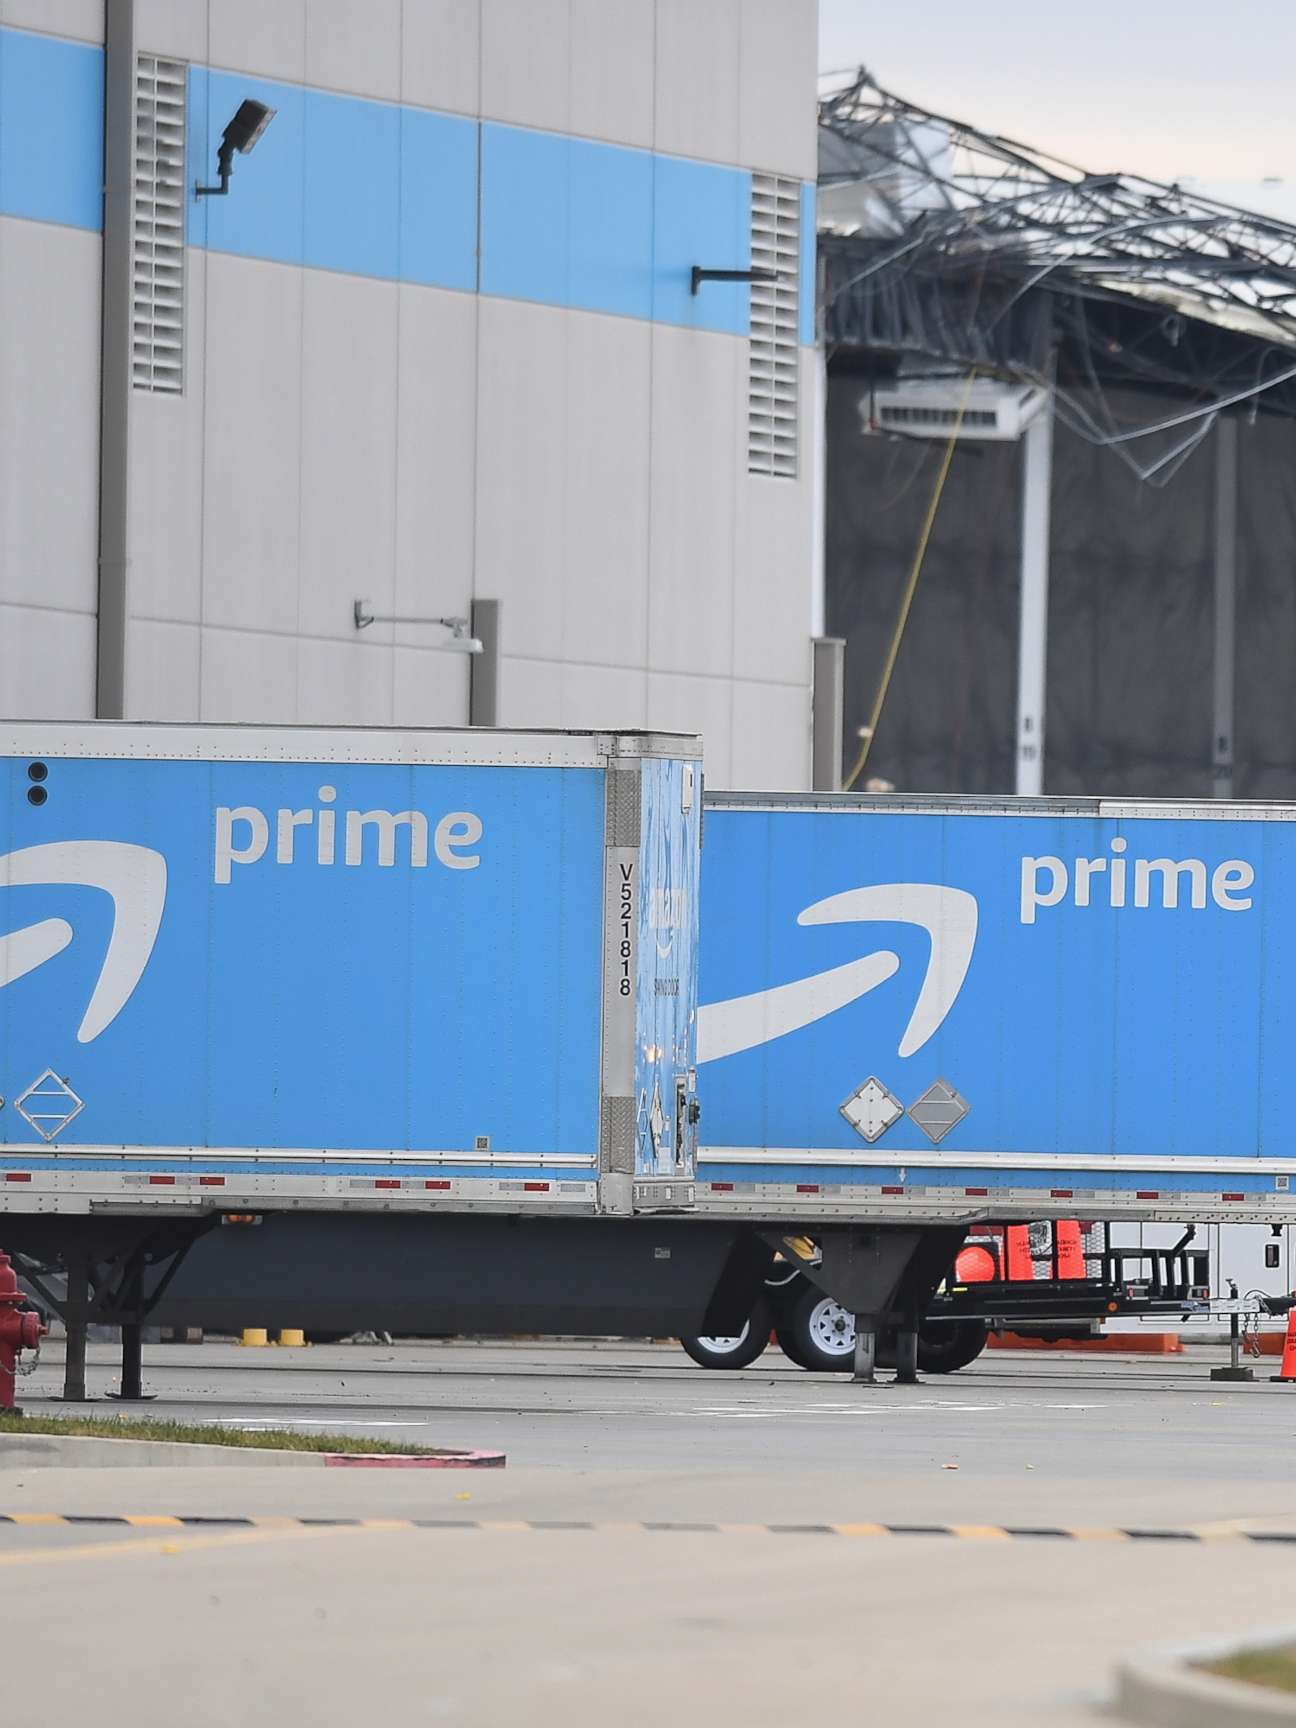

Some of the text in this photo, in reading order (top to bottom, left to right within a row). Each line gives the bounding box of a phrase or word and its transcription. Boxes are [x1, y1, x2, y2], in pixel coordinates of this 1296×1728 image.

[214, 785, 484, 885] prime
[1020, 837, 1256, 925] prime
[619, 863, 634, 997] V521818
